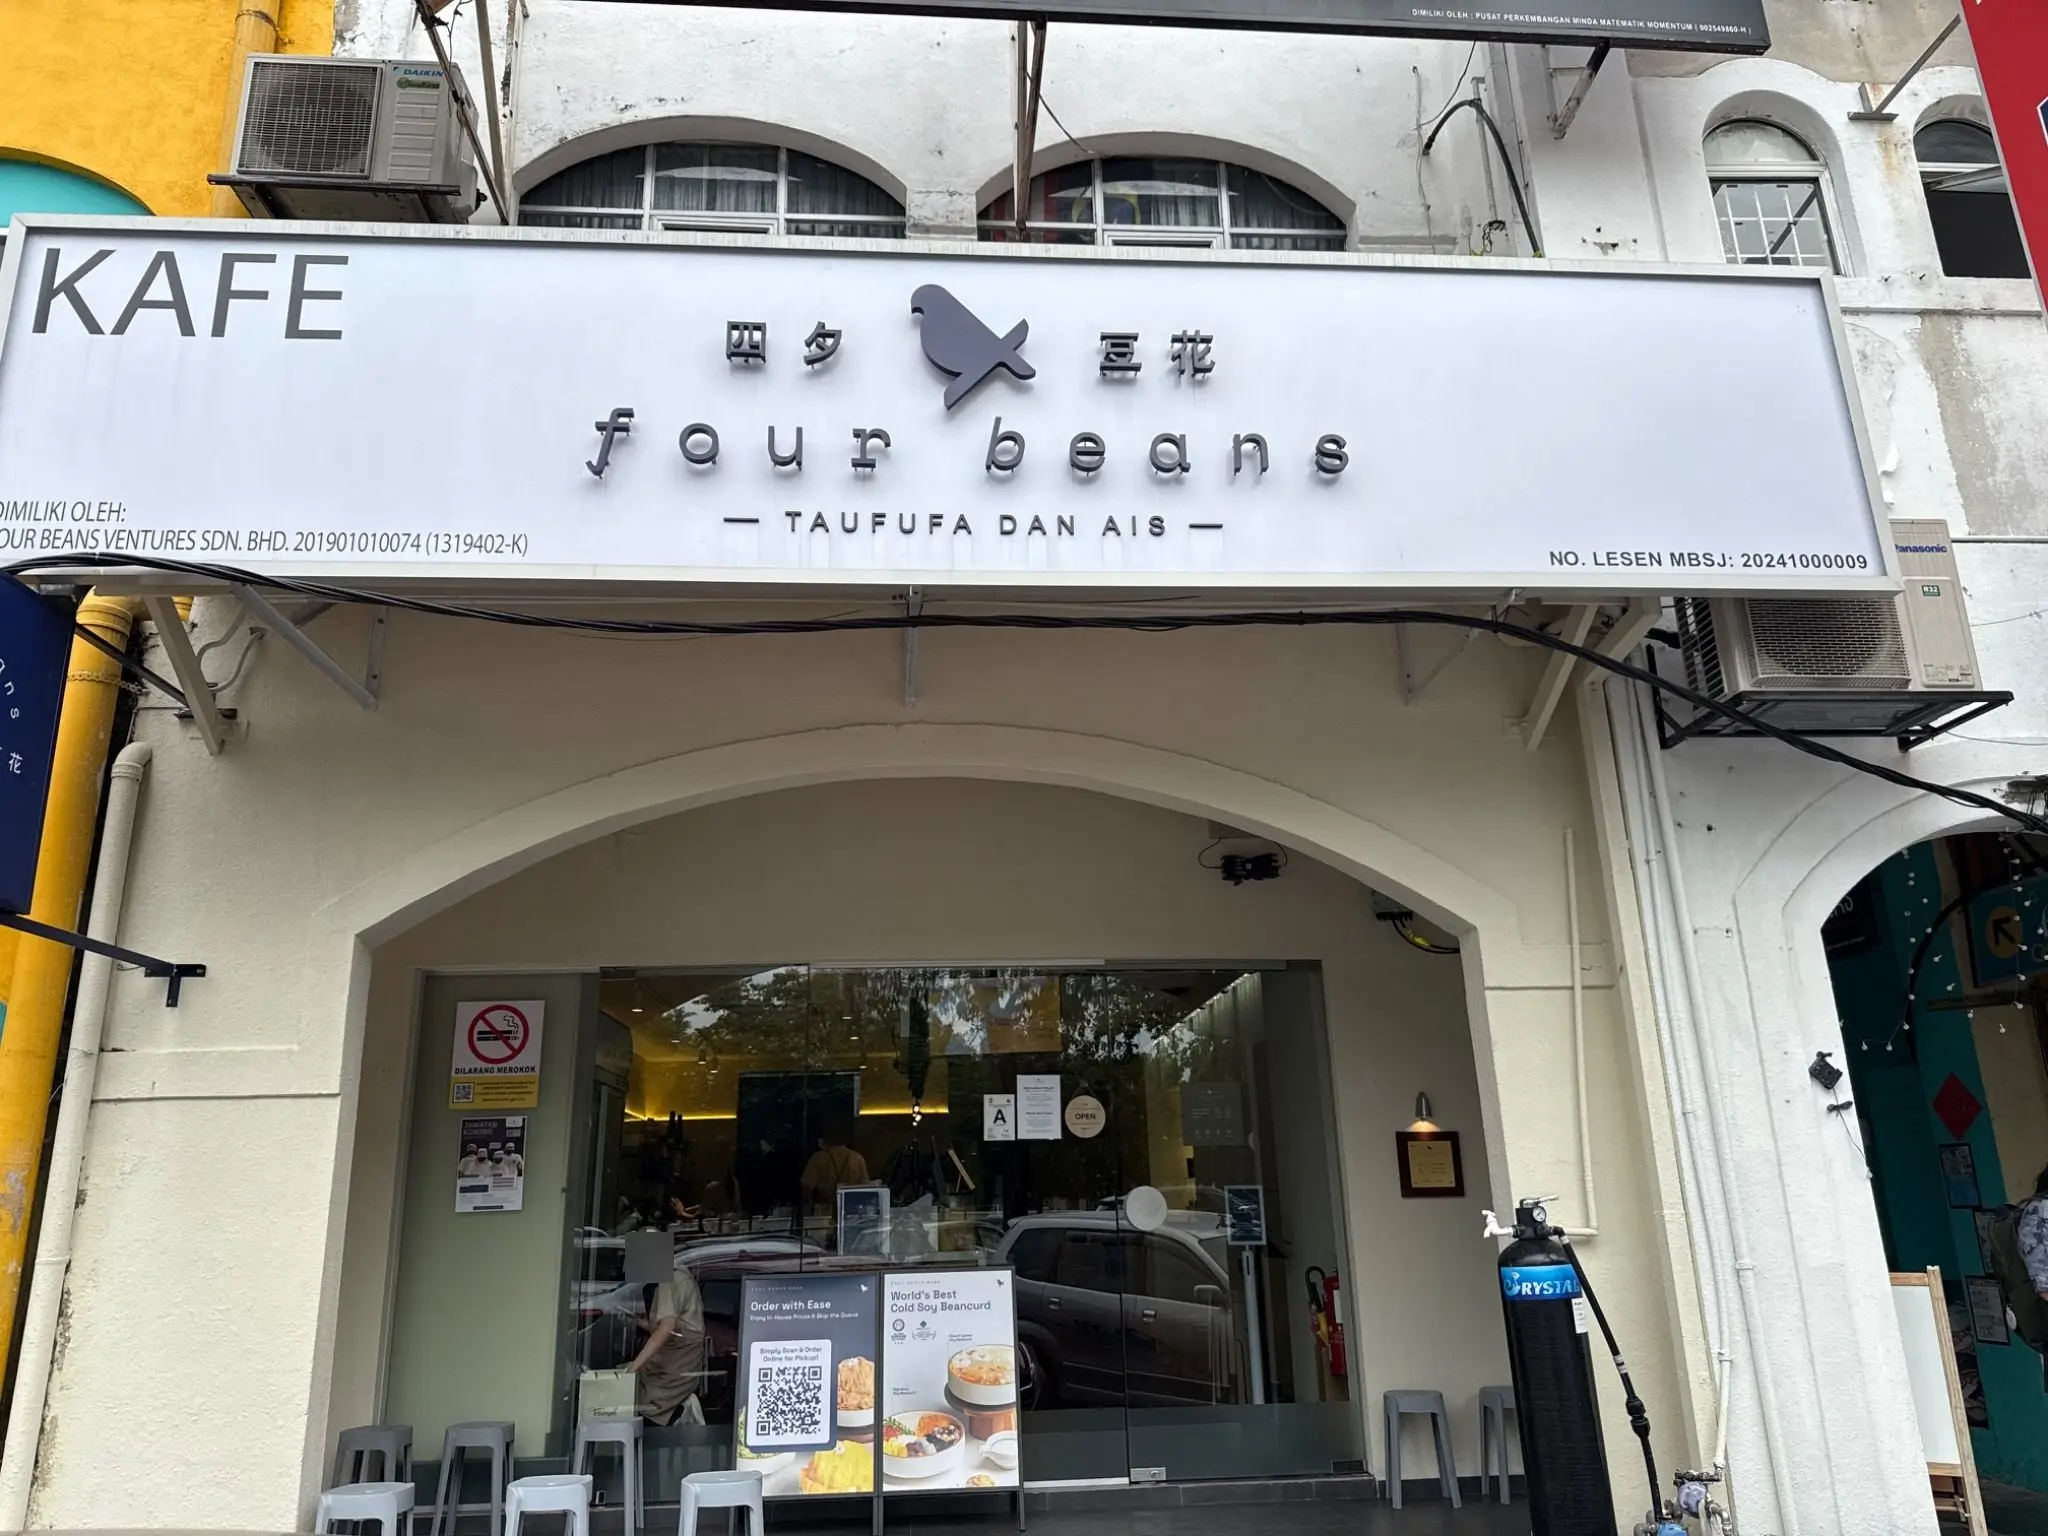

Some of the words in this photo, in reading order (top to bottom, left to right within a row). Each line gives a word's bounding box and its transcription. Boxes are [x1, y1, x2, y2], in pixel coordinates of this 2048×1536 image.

[1411, 8, 1444, 17] DIMILIKI
[1446, 10, 1468, 18] OLEH
[1475, 12, 1501, 21] PUSAT
[1503, 13, 1571, 25] PERKEMBANGAN
[1572, 16, 1598, 26] MINDA
[1599, 18, 1645, 28] MATEMATIK
[1647, 21, 1693, 31] MOMENTUM
[403, 68, 444, 77] DAIKIN
[31, 247, 350, 340] KAFE
[726, 320, 842, 366] 四夕
[1099, 330, 1216, 377] 豆花
[586, 407, 892, 478] four
[985, 416, 1349, 475] beans
[70, 501, 127, 523] OLEH:
[784, 510, 973, 535] TAUFUFA
[999, 514, 1075, 536] DAN
[1102, 515, 1166, 537] AIS
[0, 527, 37, 550] OUR
[39, 528, 101, 551] BEANS
[104, 529, 197, 551] VENTURES
[200, 530, 243, 552] SDN.
[247, 531, 289, 552] BHD.
[293, 531, 422, 553] 201901010074
[425, 532, 529, 557] (1319402-K)
[1549, 551, 1586, 567] NO.
[1593, 552, 1663, 568] LESEN
[1670, 552, 1734, 568] MBSJ:
[1741, 553, 1868, 570] 20241000009
[454, 1066, 495, 1075] DILARANG
[496, 1065, 537, 1074] MEROKOK
[992, 1108, 1007, 1124] A
[1074, 1112, 1096, 1120] OPEN
[1503, 1271, 1580, 1296] CRYSTAL
[890, 1290, 931, 1301] World's
[933, 1289, 957, 1300] Best
[750, 1301, 780, 1311] Order
[782, 1299, 805, 1310] with
[807, 1299, 832, 1310] Ease
[890, 1302, 915, 1313] Cold
[917, 1302, 938, 1314] Soy
[940, 1300, 991, 1312] Beancurd
[760, 1347, 781, 1355] Simply
[763, 1354, 783, 1362] Online
